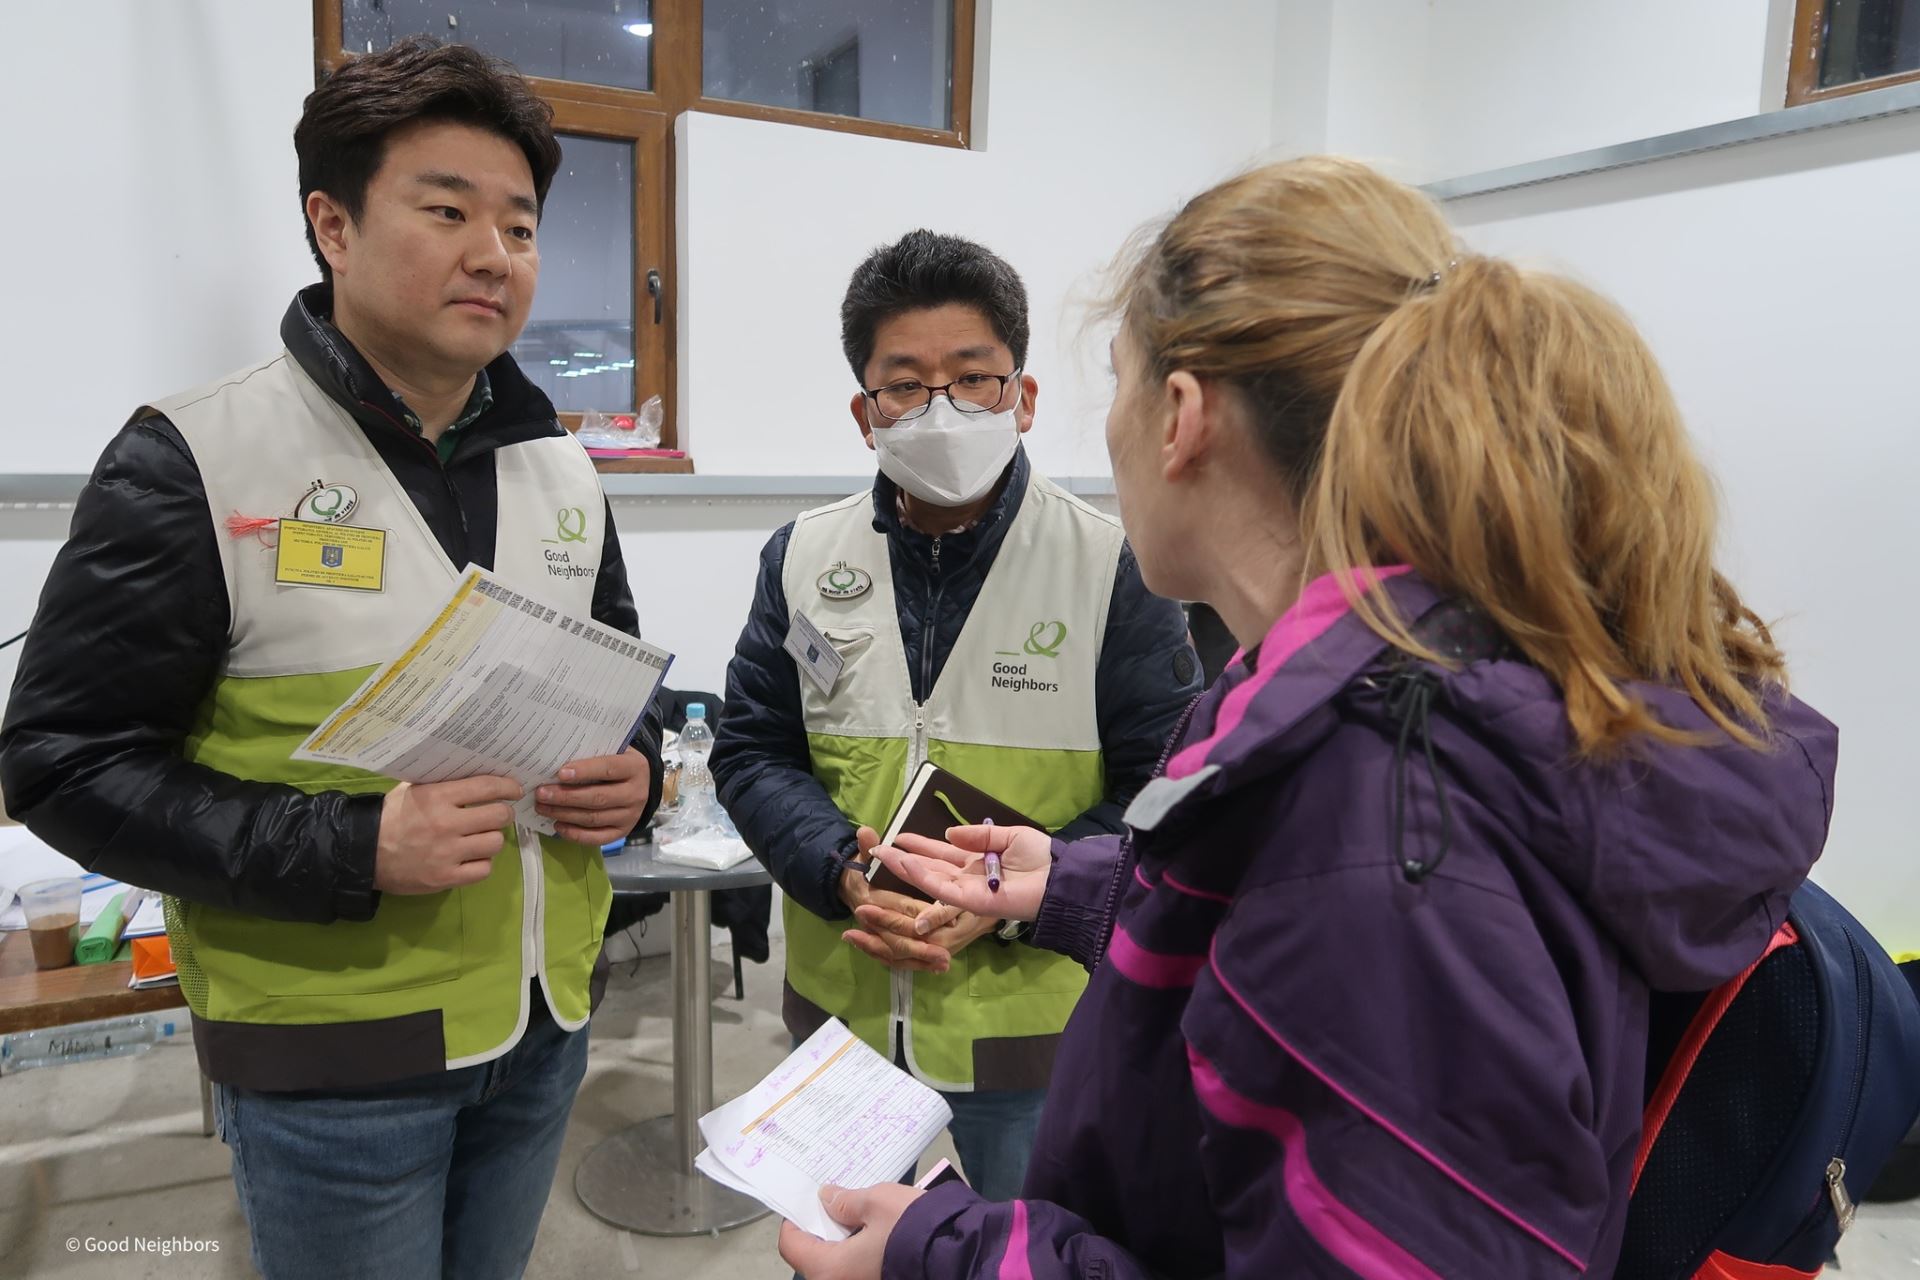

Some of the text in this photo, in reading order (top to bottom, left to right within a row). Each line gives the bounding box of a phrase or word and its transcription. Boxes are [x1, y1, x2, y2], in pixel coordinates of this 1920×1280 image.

[544, 549, 570, 563] Good
[547, 564, 595, 580] Neighbors
[992, 661, 1027, 676] Good
[991, 675, 1059, 693] Neighbors
